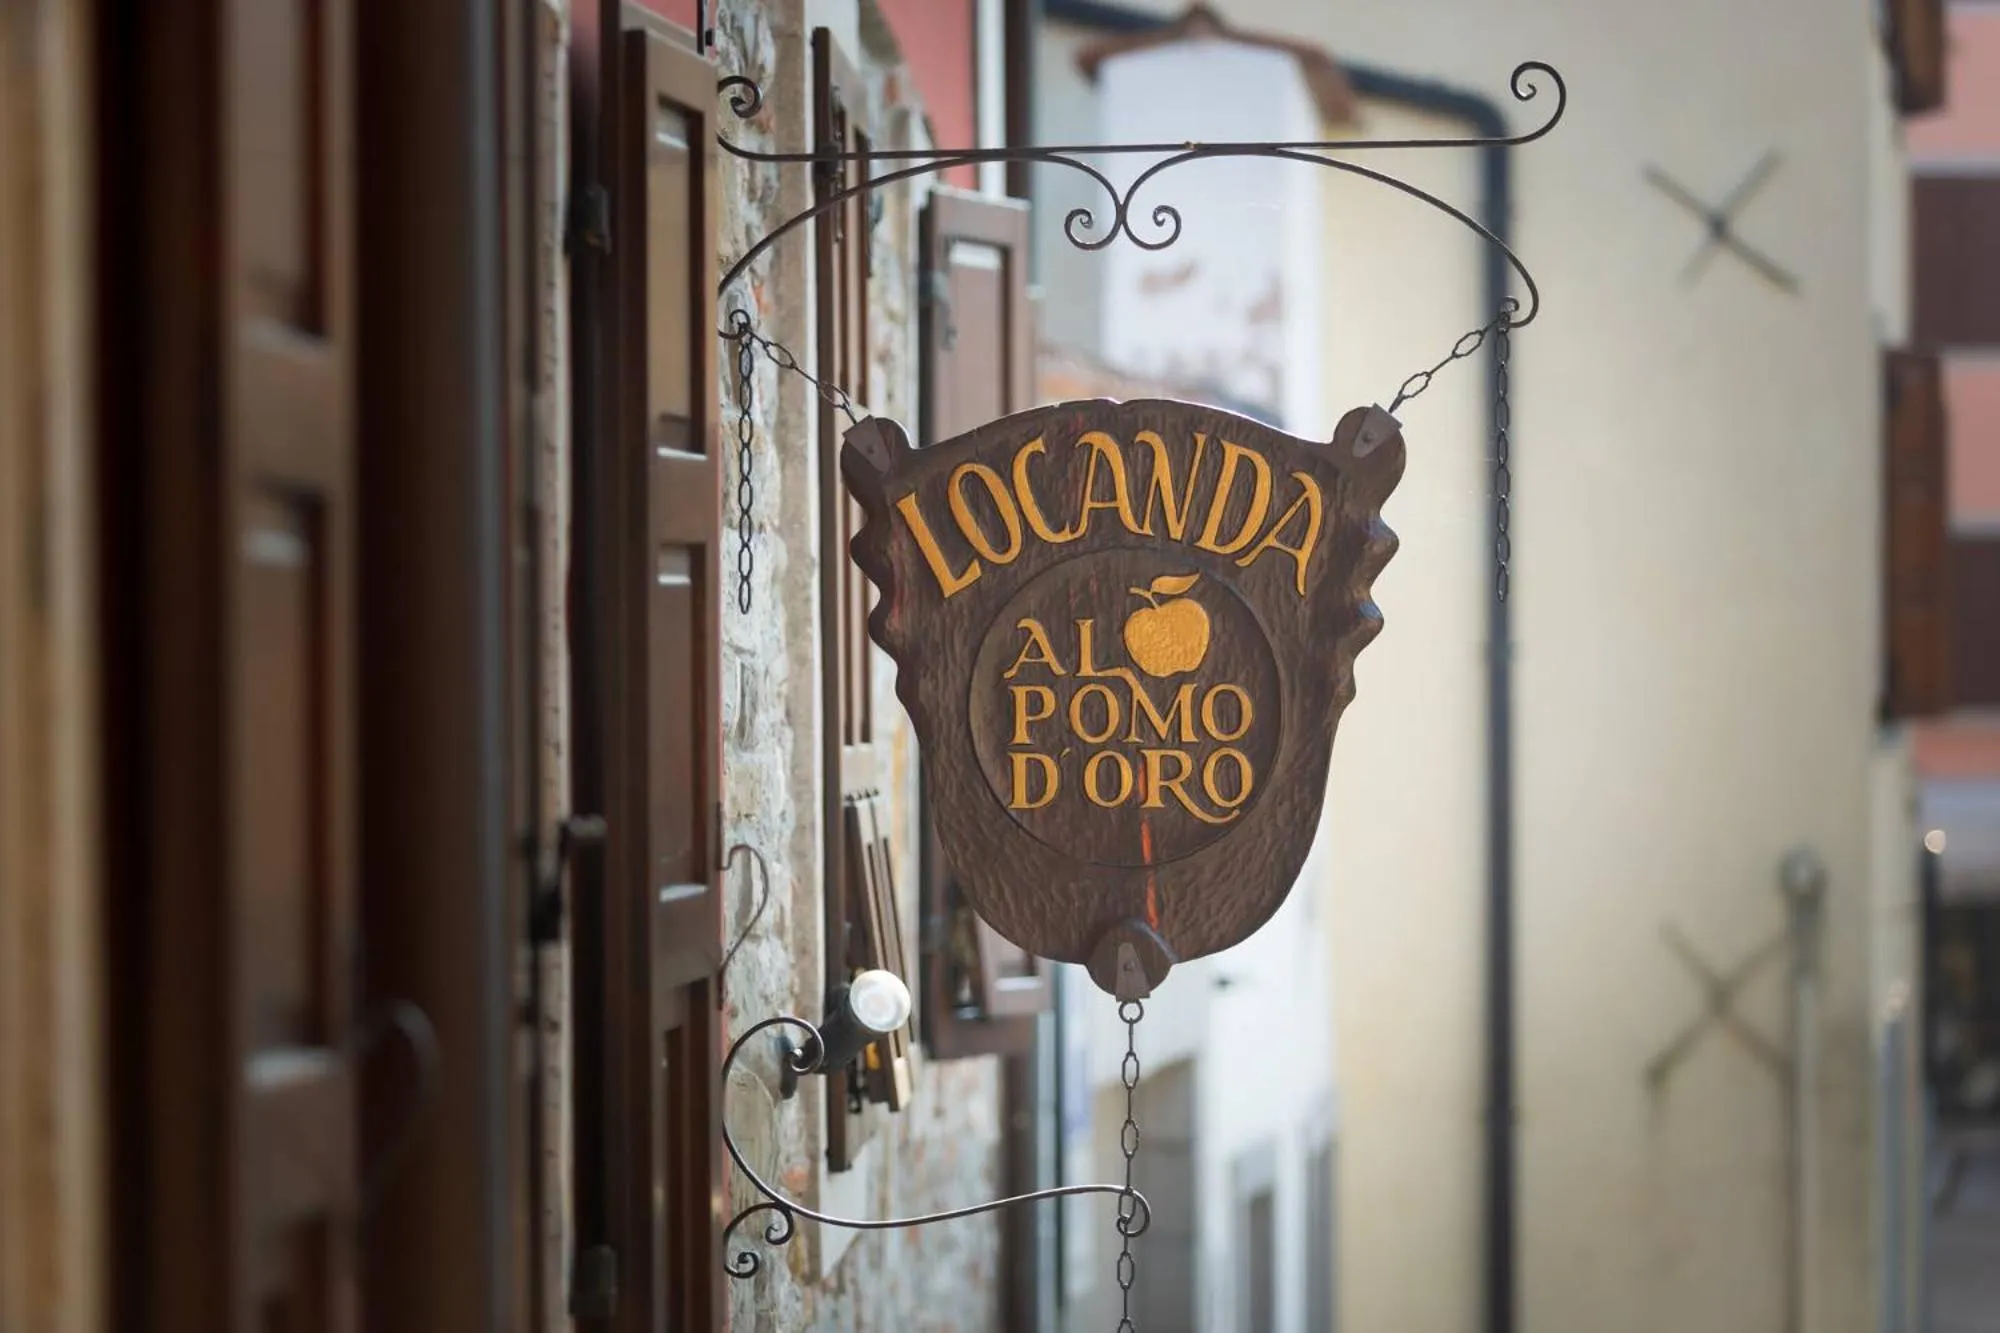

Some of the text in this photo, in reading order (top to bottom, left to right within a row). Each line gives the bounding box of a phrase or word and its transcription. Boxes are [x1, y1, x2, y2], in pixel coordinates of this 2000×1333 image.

[897, 430, 1322, 598] LOCANDA
[1003, 618, 1125, 679] AL
[1008, 683, 1255, 745] POMO
